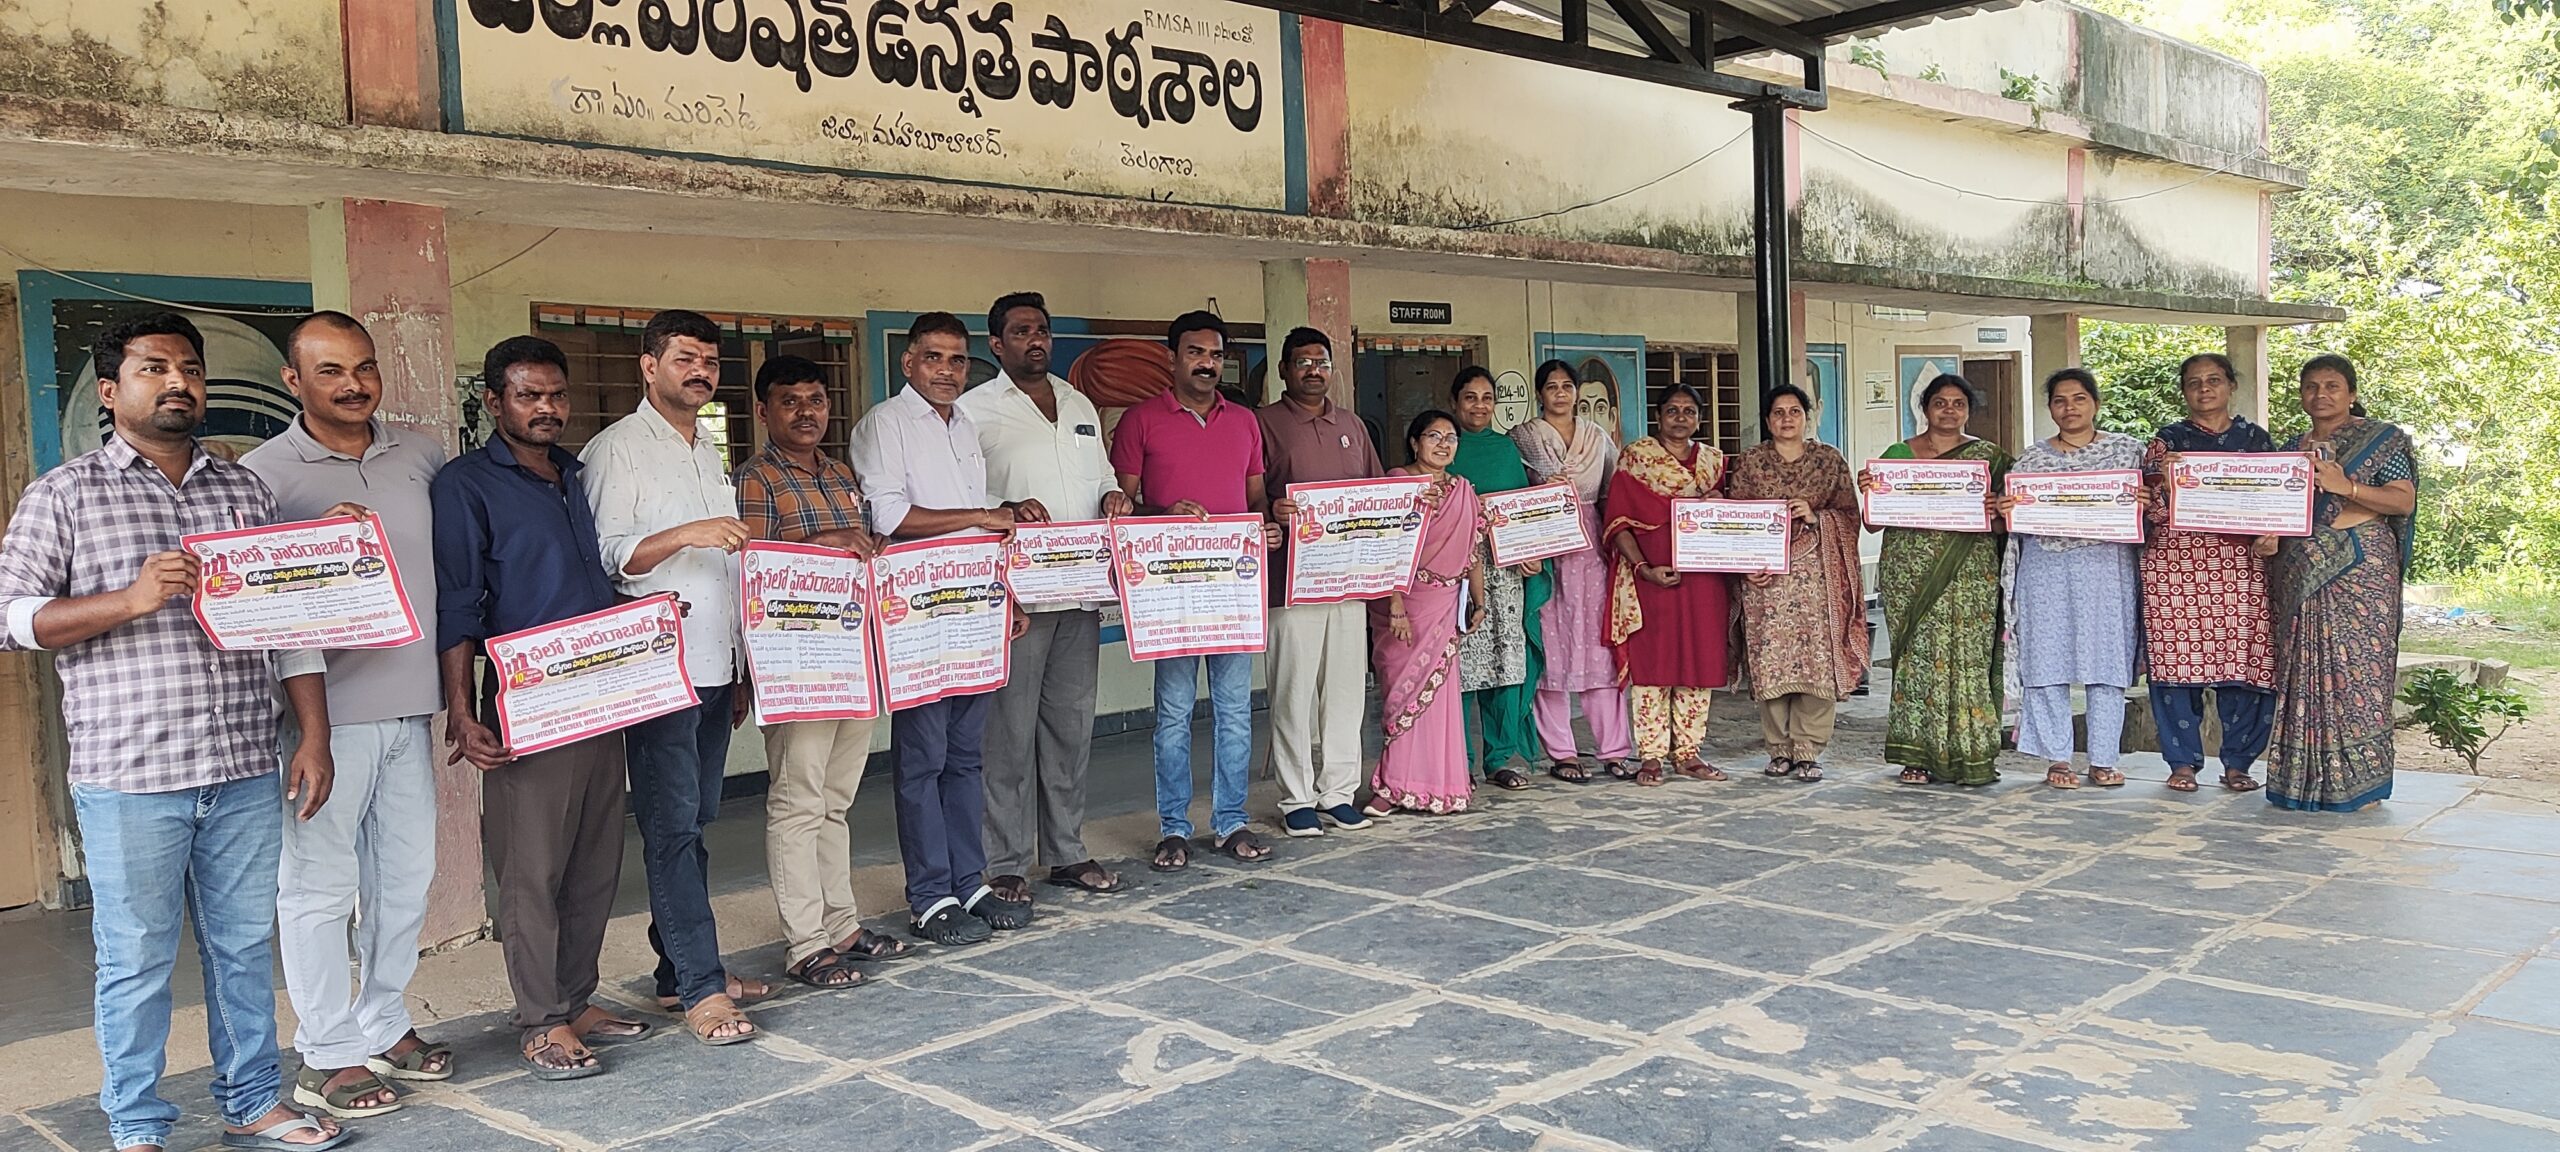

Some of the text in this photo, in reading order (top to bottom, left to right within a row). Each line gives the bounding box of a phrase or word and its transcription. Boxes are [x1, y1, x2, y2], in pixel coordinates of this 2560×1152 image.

[1028, 14, 1263, 132] పాఠశాల
[1391, 307, 1445, 320] STAFF ROOM
[1505, 406, 1514, 421] 16
